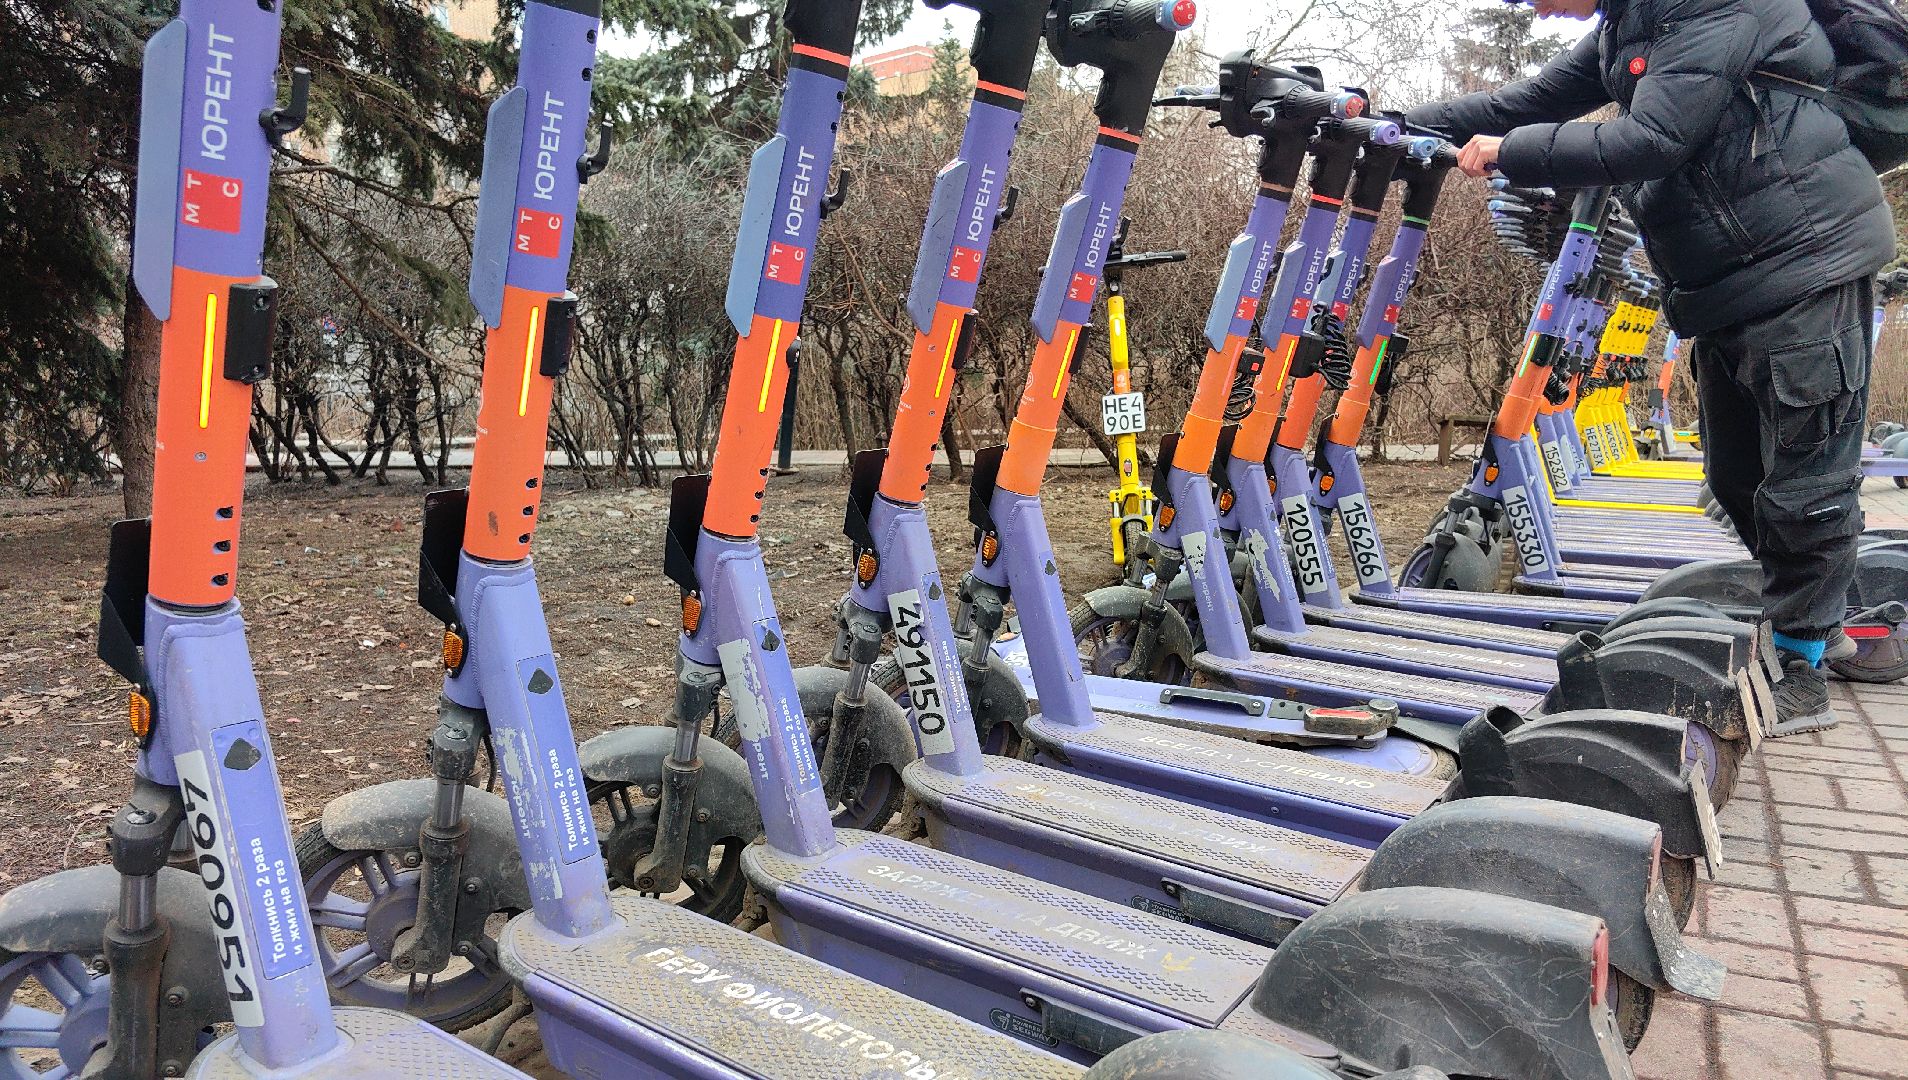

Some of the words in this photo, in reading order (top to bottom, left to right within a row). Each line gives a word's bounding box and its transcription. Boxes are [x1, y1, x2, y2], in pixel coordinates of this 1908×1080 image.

[200, 23, 235, 161] ЮРЕНТ
[533, 90, 565, 200] ЮРЕНТ
[784, 145, 815, 237] ЮРЕНТ
[967, 163, 996, 242] ЮРЕНТ
[1084, 201, 1112, 268] ЮРЕНТ
[1250, 240, 1273, 294] ЮРЕНТ
[1303, 247, 1324, 295] ЮРЕНТ
[1342, 255, 1362, 299] ЮРЕНТ
[1394, 261, 1414, 301] ЮРЕНТ
[1545, 446, 1568, 488] 152322
[1287, 503, 1324, 586] 120555
[1344, 502, 1382, 577] 156266
[1506, 493, 1545, 566] 155330
[896, 607, 945, 735] 491150
[780, 697, 793, 723] раза
[785, 722, 794, 732] 2
[549, 748, 563, 779] раза
[566, 767, 576, 788] газ
[1240, 758, 1376, 790] УСПЕВАЮ
[554, 780, 565, 789] 2
[572, 789, 580, 806] на
[559, 790, 578, 851] Толкнись
[575, 807, 588, 836] жми
[251, 837, 270, 875] раза
[582, 836, 590, 846] и
[183, 777, 253, 1002] 490951
[256, 875, 270, 888] 2
[275, 859, 289, 885] газ
[280, 885, 293, 905] на
[264, 888, 286, 963] Толкнись
[285, 907, 301, 943] жми
[1045, 922, 1157, 960] ДВИЖ
[293, 943, 303, 956] и
[1012, 1024, 1051, 1041] SEGWAY
